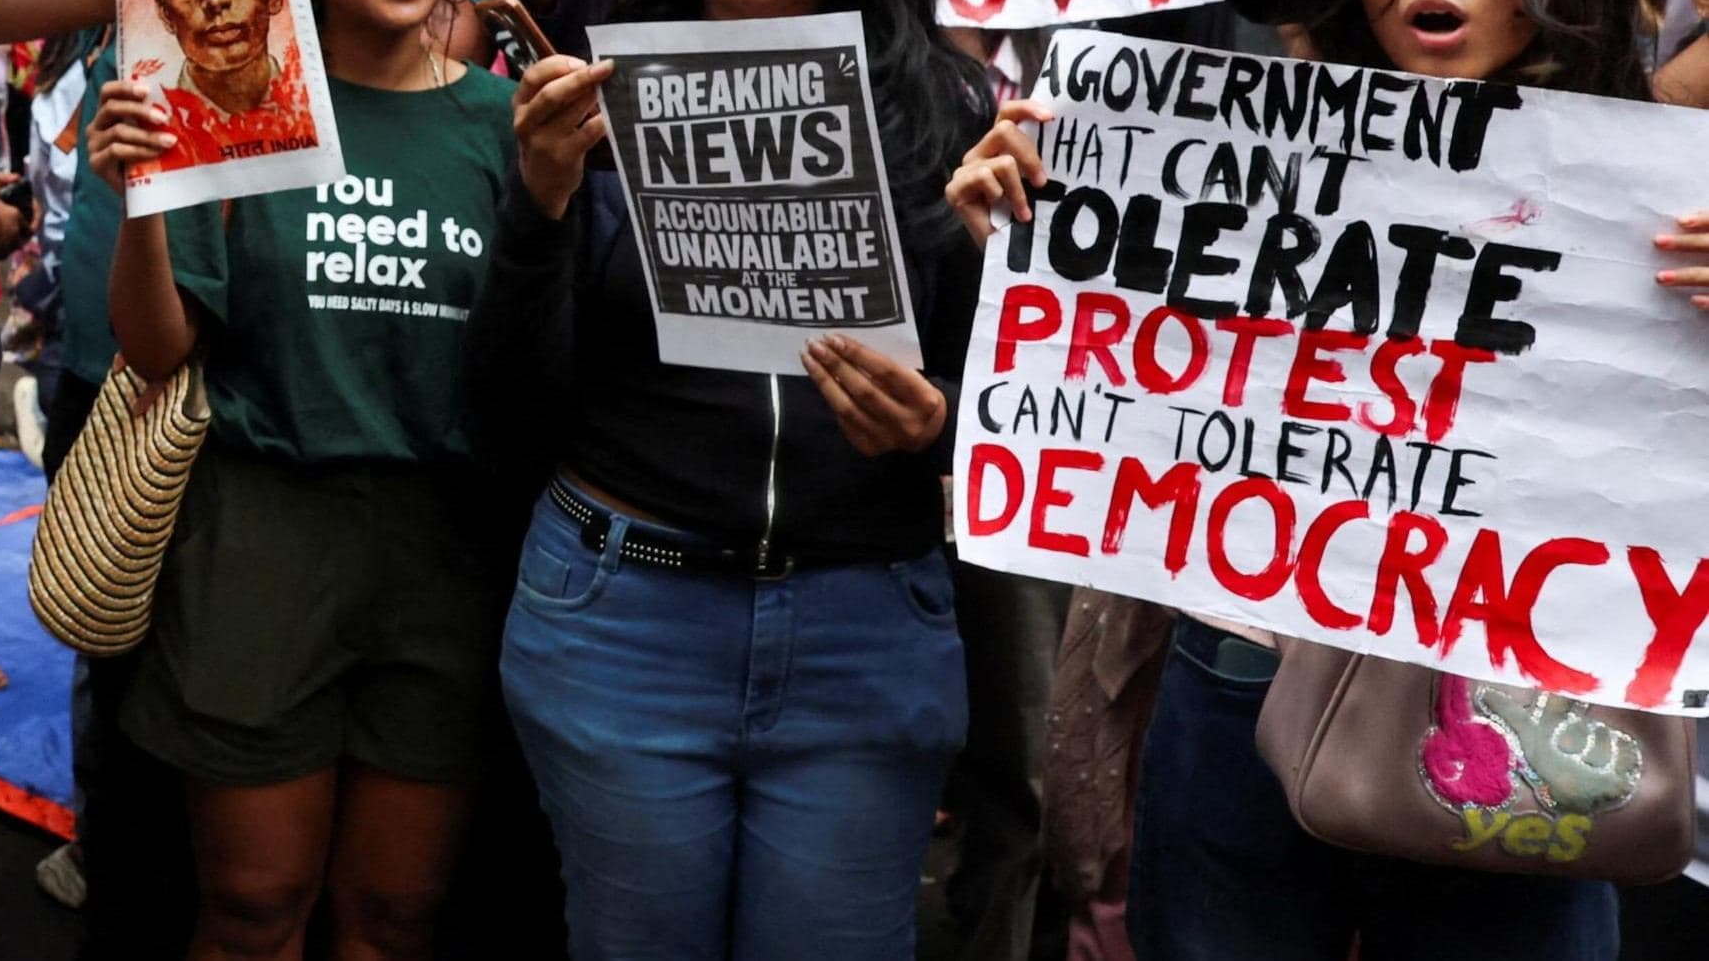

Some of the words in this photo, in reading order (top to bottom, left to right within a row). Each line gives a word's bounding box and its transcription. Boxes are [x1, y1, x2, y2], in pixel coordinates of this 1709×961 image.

[637, 61, 826, 120] BREAKING
[1041, 41, 1061, 97] A
[1067, 46, 1523, 172] GOVERNMENT
[271, 135, 319, 153] INDIA
[1161, 139, 1370, 216] CAN'T
[306, 209, 428, 249] need
[441, 217, 484, 258] to
[654, 199, 871, 233] ACCOUNTABILITY
[306, 241, 428, 289] relax
[656, 231, 879, 271] UNAVAILABLE
[1006, 178, 1562, 356] TOLERATE
[684, 283, 870, 320] MOMENT
[741, 270, 760, 287] AT
[764, 270, 798, 288] THE
[308, 295, 326, 309] YOU
[326, 295, 350, 310] NEED
[350, 296, 378, 311] SALTY
[378, 298, 402, 314] DAYS
[402, 300, 411, 315] &
[411, 302, 438, 317] SLOW
[993, 284, 1496, 443] PROTEST
[978, 380, 1136, 443] CAN'T
[1168, 405, 1498, 517] TOLERATE
[1451, 807, 1594, 862] yes
